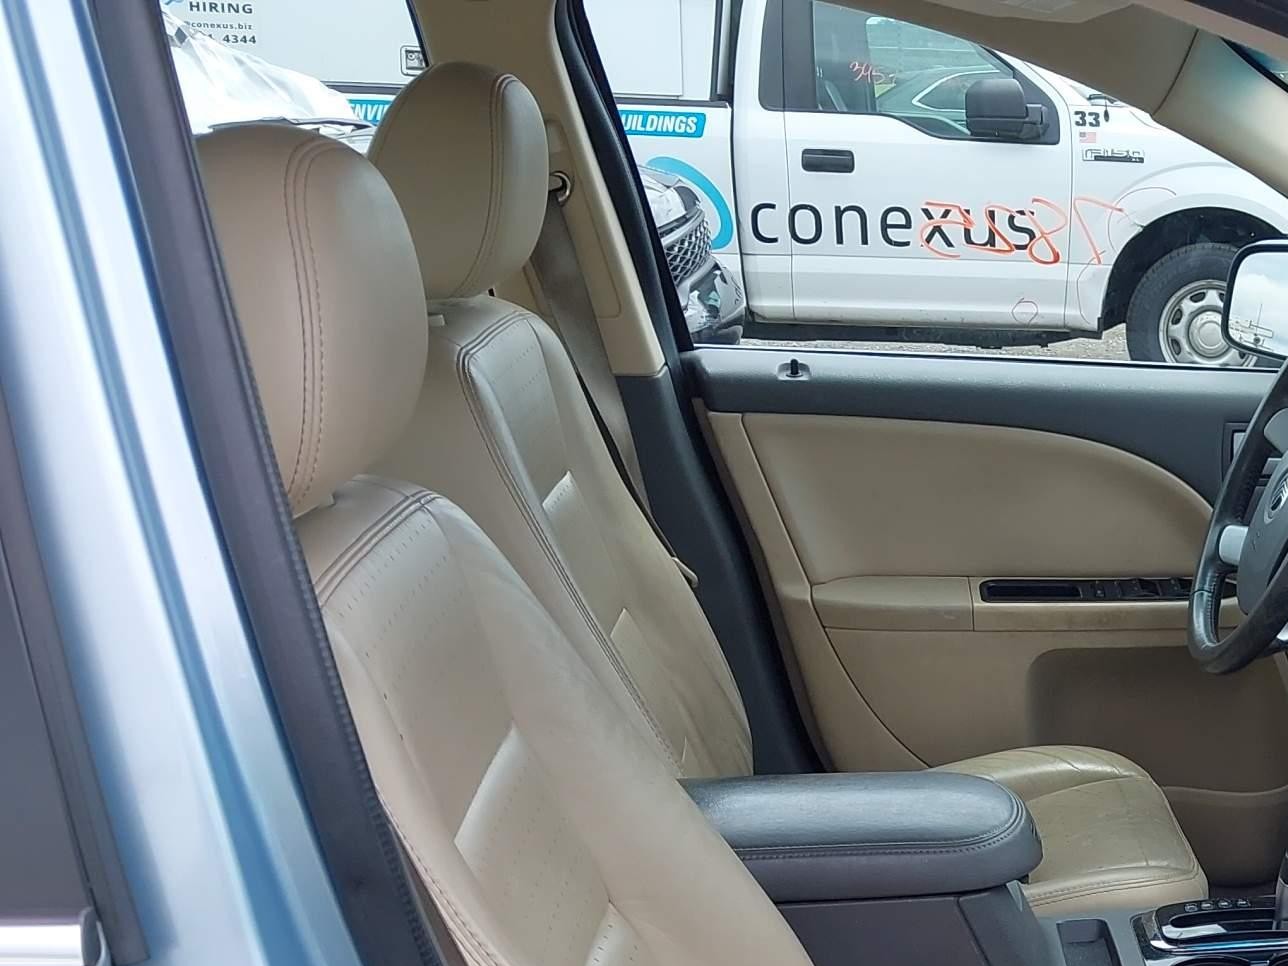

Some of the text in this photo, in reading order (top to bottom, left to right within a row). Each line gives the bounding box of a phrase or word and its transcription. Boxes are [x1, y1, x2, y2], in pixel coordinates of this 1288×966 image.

[189, 1, 253, 14] HIRING
[223, 34, 256, 44] 4344
[621, 113, 697, 133] UILDINGS
[1074, 111, 1100, 127] 33
[750, 202, 1035, 250] conexus
